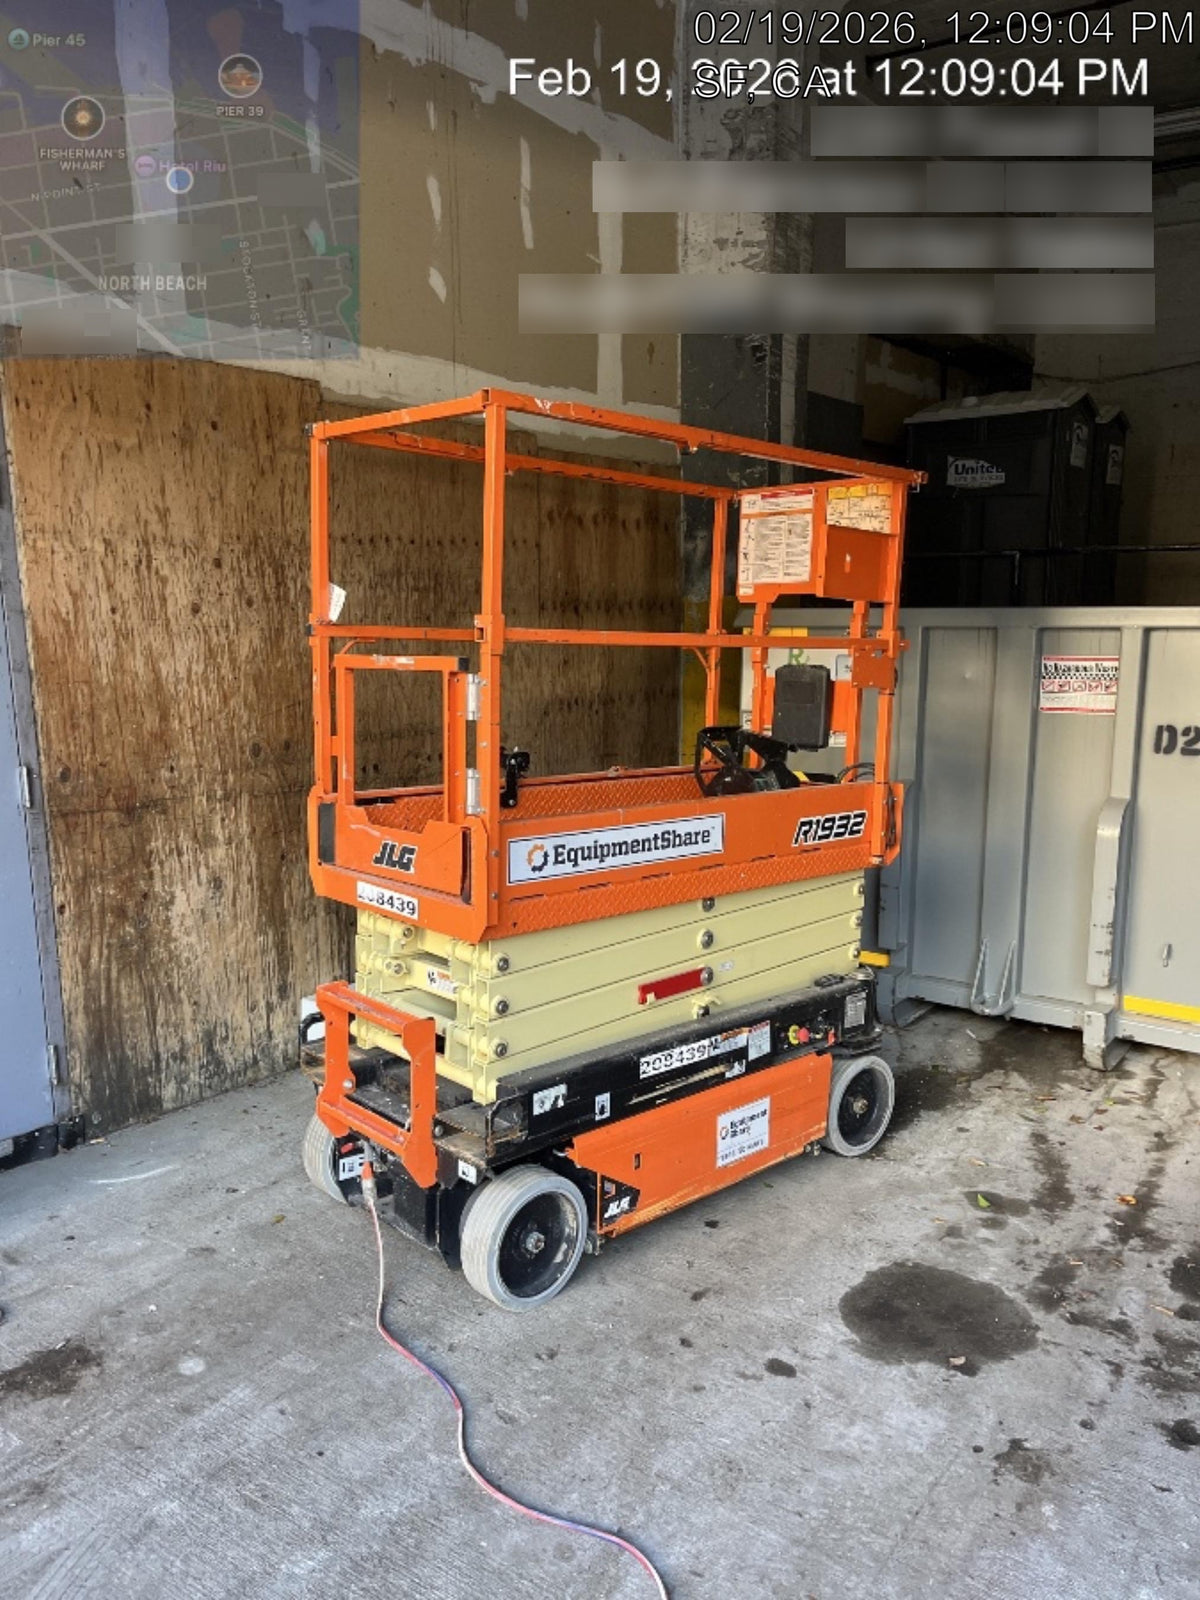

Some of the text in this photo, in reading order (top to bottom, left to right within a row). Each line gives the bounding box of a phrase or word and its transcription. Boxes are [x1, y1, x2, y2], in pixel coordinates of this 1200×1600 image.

[793, 811, 867, 846] R1932
[373, 842, 417, 872] JLG
[553, 829, 710, 867] EquipmentShare
